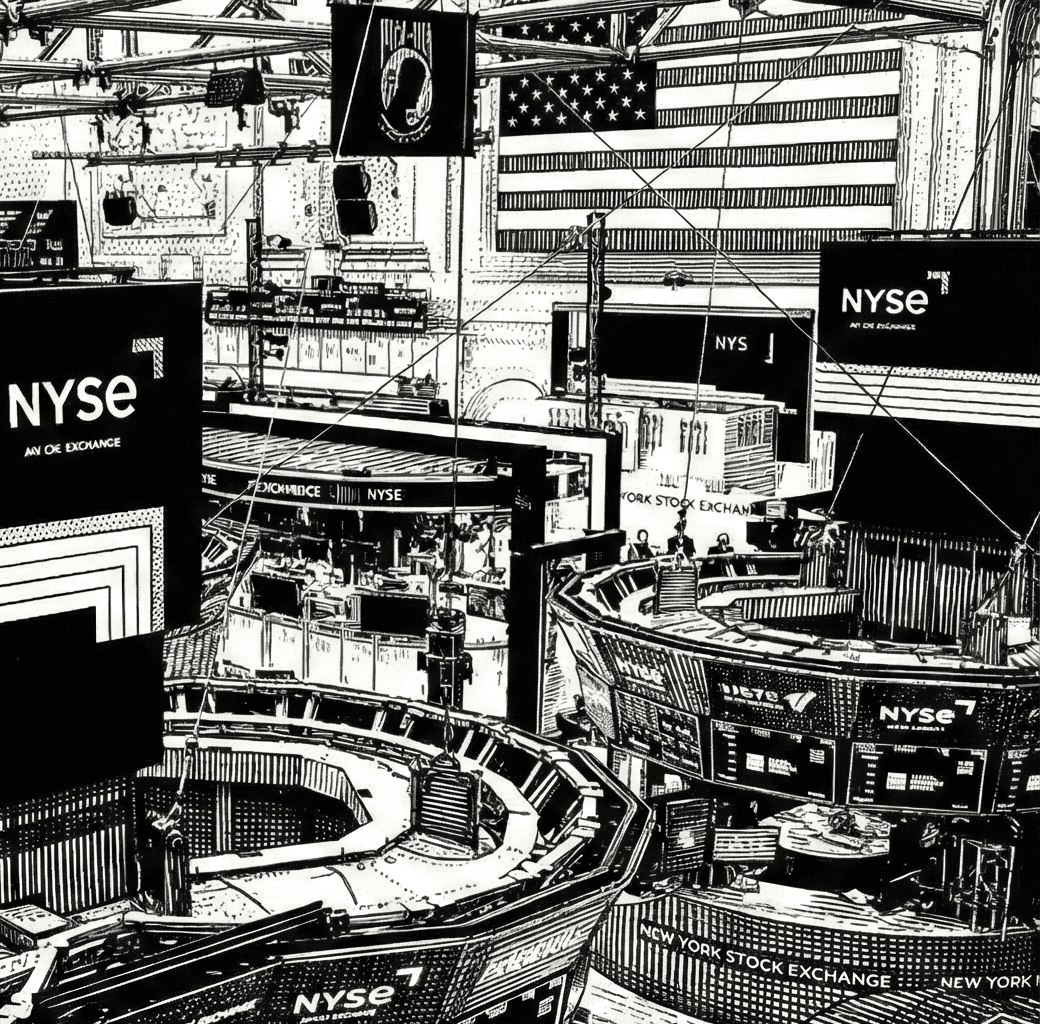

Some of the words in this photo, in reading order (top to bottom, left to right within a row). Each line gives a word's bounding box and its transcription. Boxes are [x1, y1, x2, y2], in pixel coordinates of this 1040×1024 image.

[367, 488, 402, 501] NYSE
[677, 935, 722, 960] YORK
[725, 950, 784, 975] STOCK
[788, 964, 892, 988] EXCHANGE
[940, 976, 982, 989] NEW
[985, 974, 1032, 989] YORK
